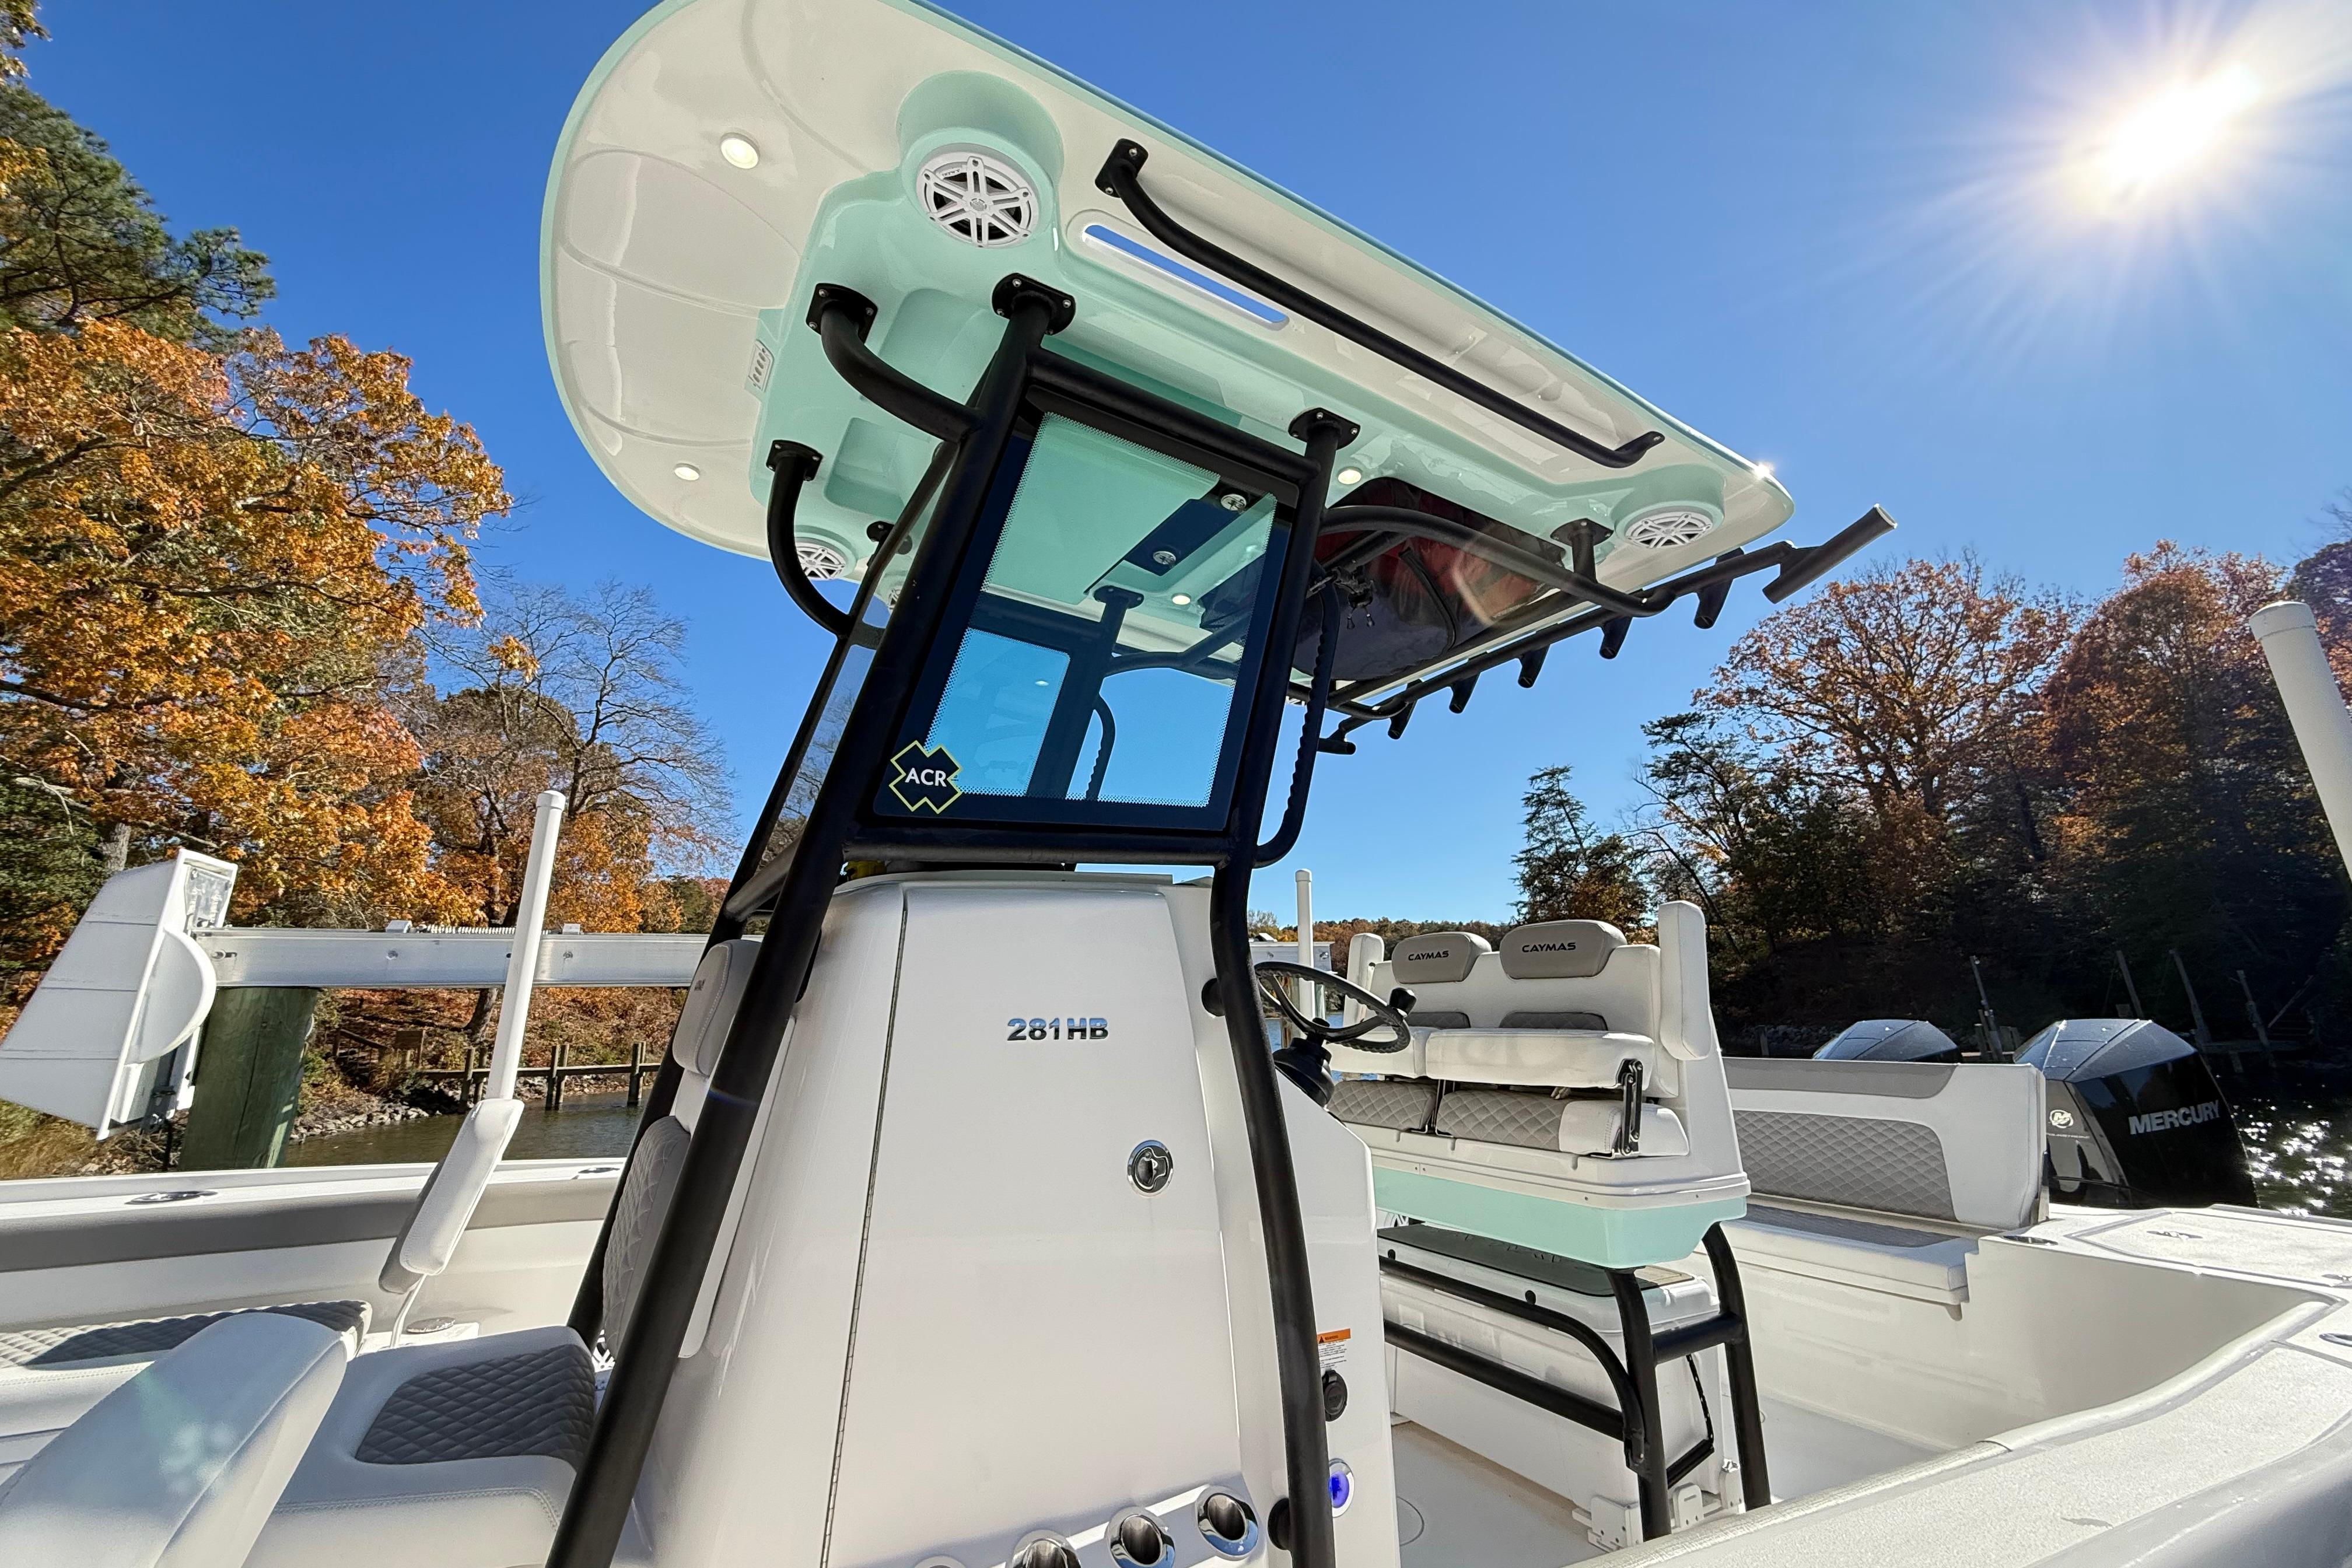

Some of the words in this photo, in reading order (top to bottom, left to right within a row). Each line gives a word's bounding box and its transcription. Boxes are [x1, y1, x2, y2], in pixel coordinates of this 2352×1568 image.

[905, 768, 947, 787] ACR
[1521, 942, 1576, 953] CAYMAS
[1408, 950, 1449, 961] CAYMAS
[2129, 1100, 2220, 1134] MERCURY
